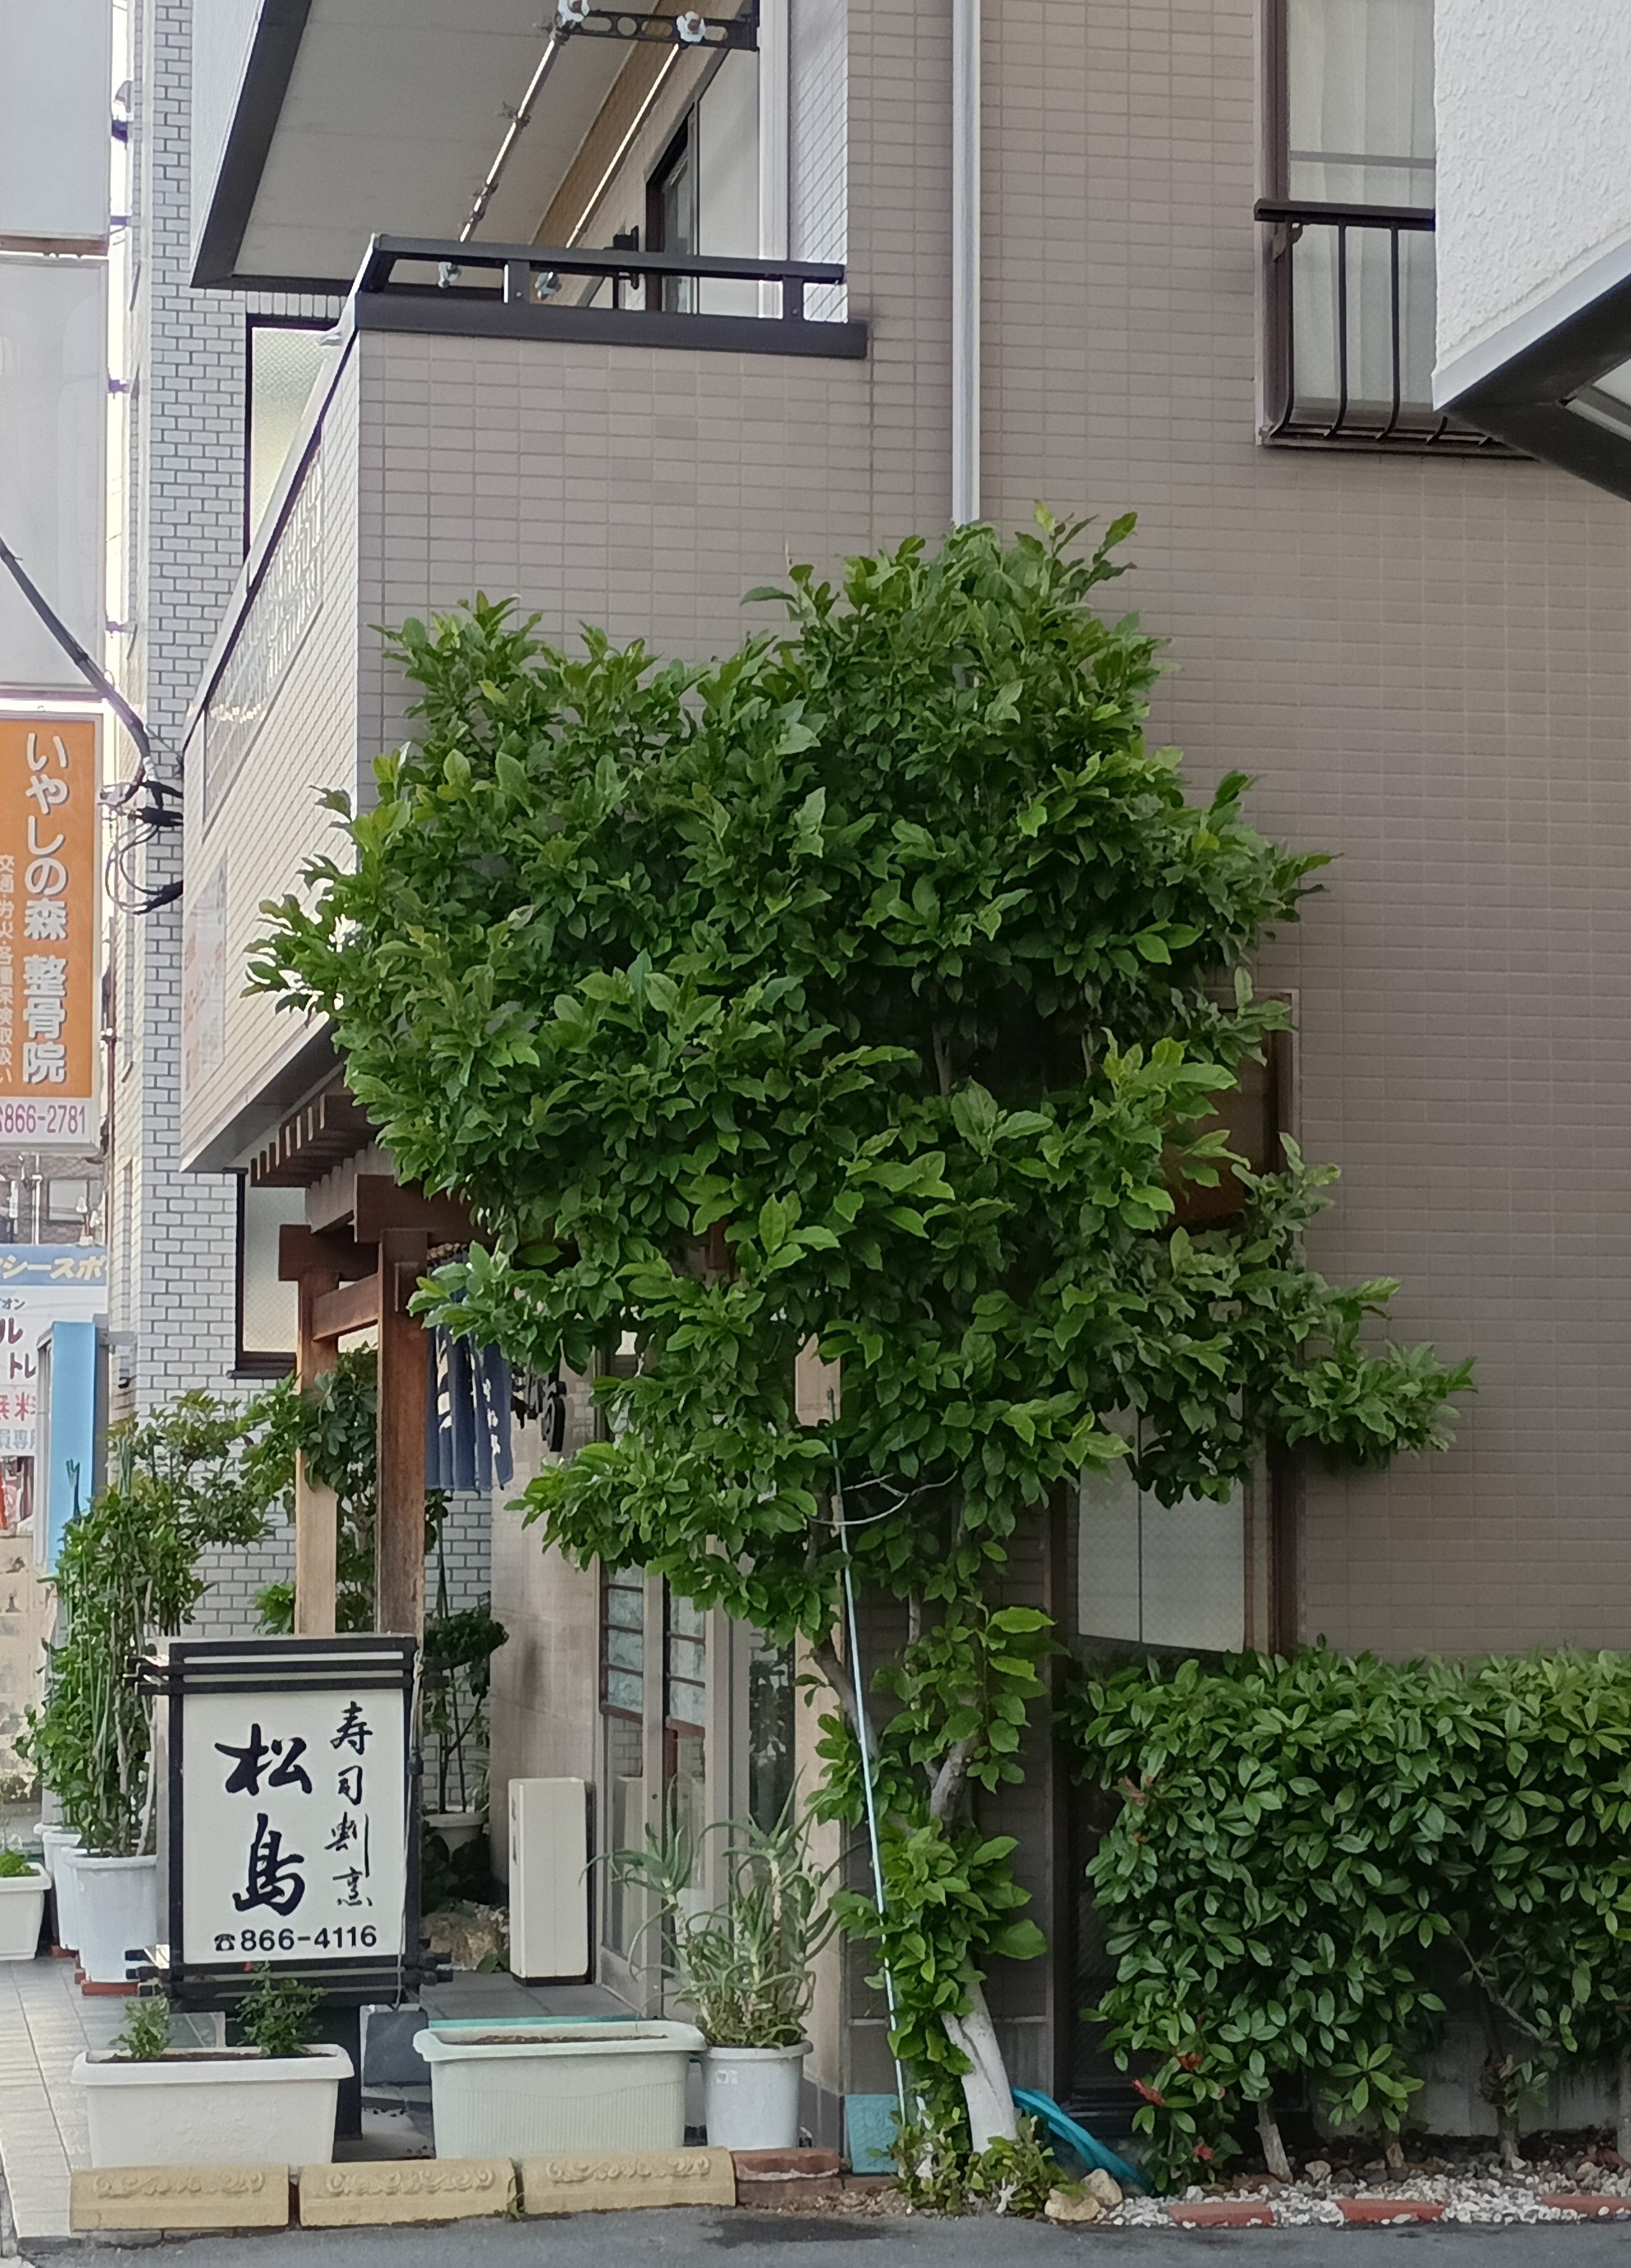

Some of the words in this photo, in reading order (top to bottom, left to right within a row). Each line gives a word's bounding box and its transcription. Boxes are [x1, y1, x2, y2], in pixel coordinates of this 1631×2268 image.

[25, 733, 68, 941] いやしの森
[22, 955, 66, 1083] 整骨院
[0, 1255, 108, 1280] シースポ
[214, 1723, 313, 1916] 松島
[324, 1701, 374, 1907] 寿司割烹
[241, 1924, 377, 1952] 866-4116
